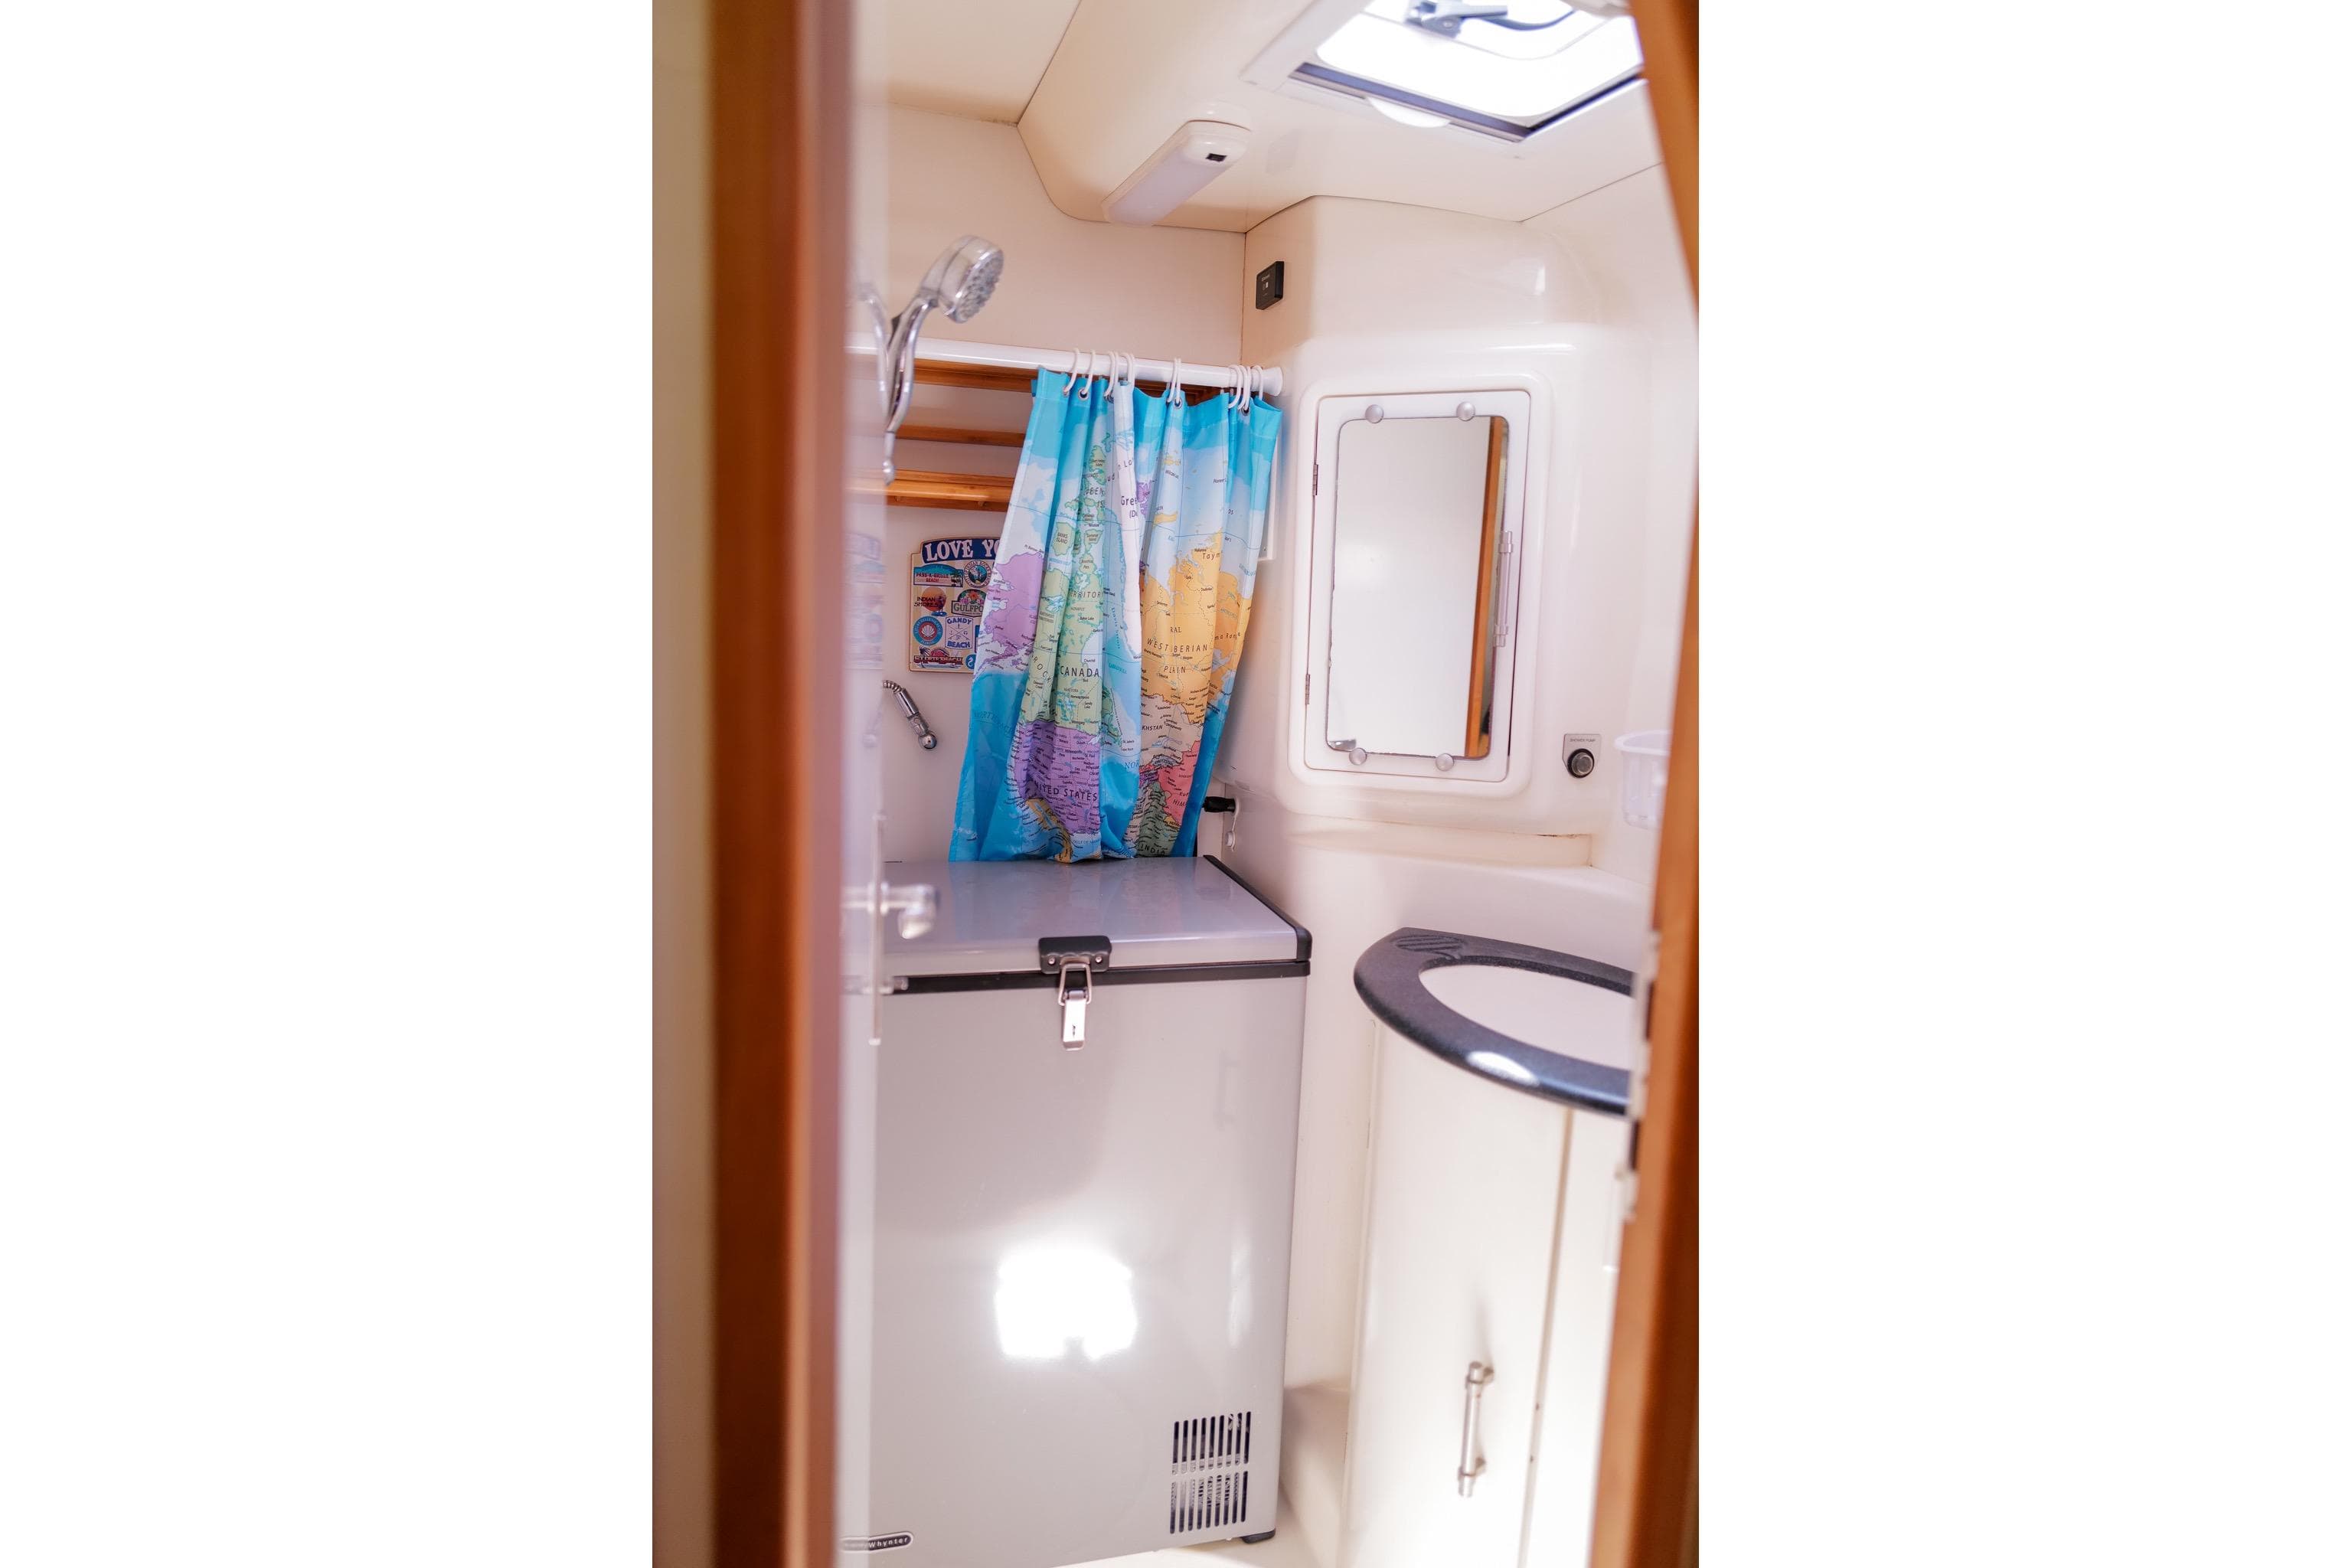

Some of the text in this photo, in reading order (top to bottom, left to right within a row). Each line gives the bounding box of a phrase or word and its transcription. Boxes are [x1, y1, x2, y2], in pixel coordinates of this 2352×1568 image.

[925, 539, 973, 561] LOVE
[953, 603, 983, 612] GULFPO
[1147, 637, 1207, 653] WEST BERIAN
[1060, 665, 1099, 678] CANADA
[1164, 665, 1186, 674] PLAIN
[1064, 788, 1097, 801] STATES
[1140, 844, 1165, 854] INDIA
[868, 1536, 909, 1549] Whynter
